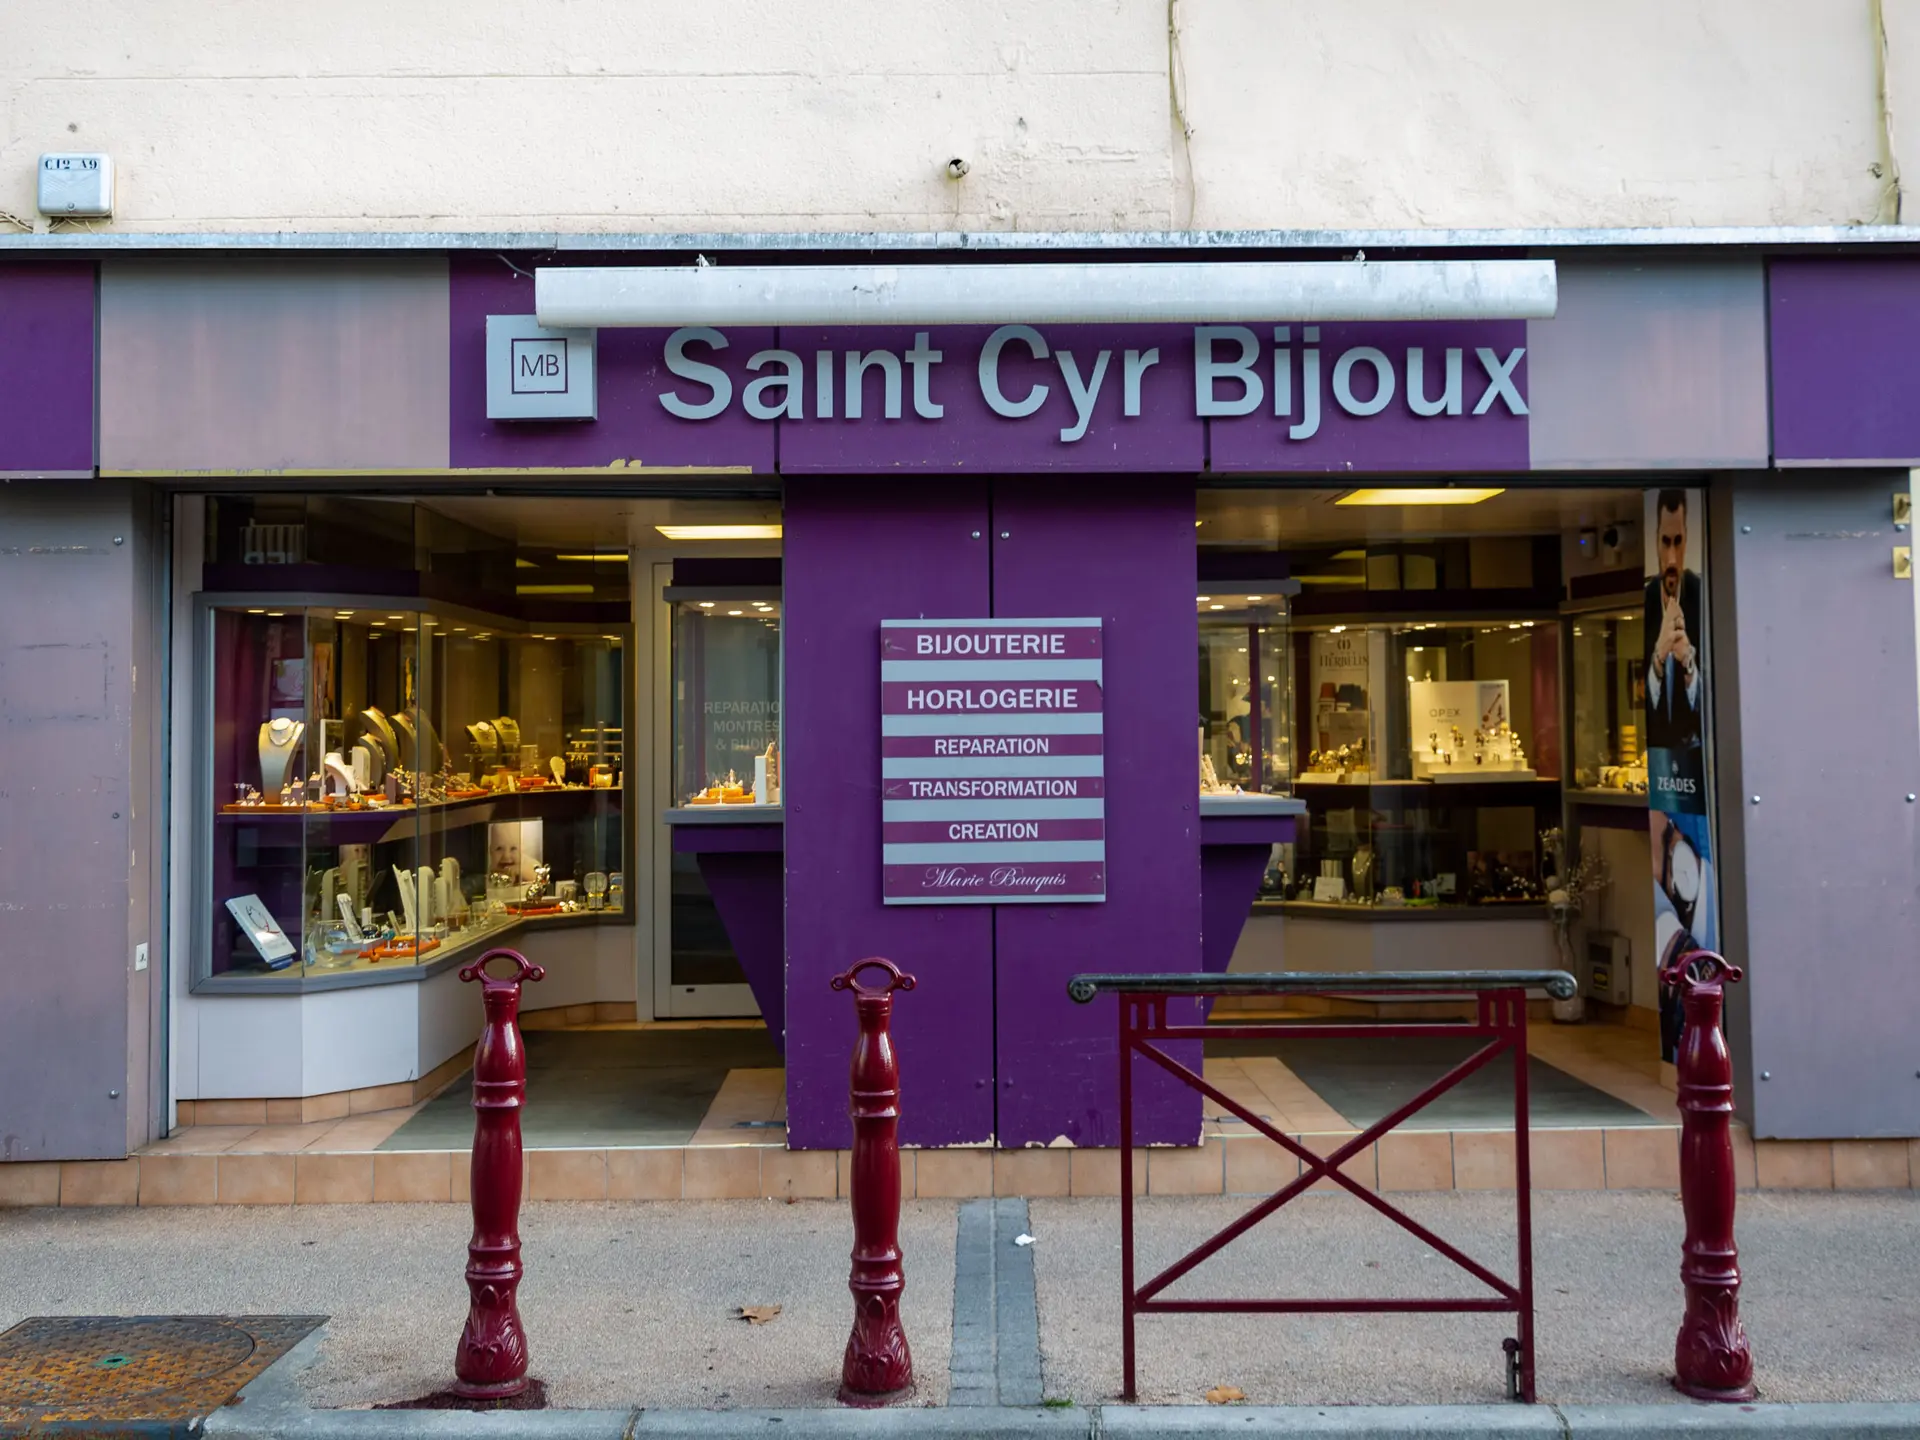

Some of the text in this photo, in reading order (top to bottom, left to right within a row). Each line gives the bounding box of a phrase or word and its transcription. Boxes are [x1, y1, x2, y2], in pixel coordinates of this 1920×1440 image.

[44, 158, 71, 170] C12
[521, 354, 560, 377] MB
[658, 323, 1530, 443] Saint Cyr Bijoux
[916, 634, 1066, 655] BIJOUTERIE
[907, 688, 1078, 710] HORLOGERIE
[1429, 708, 1462, 718] OPEX
[934, 738, 1049, 755] REPARATION
[909, 780, 1077, 797] TRANSFORMATION
[1657, 776, 1696, 793] ZEADES
[948, 823, 1039, 840] CREATION
[922, 867, 1067, 892] Marie Bauquis
